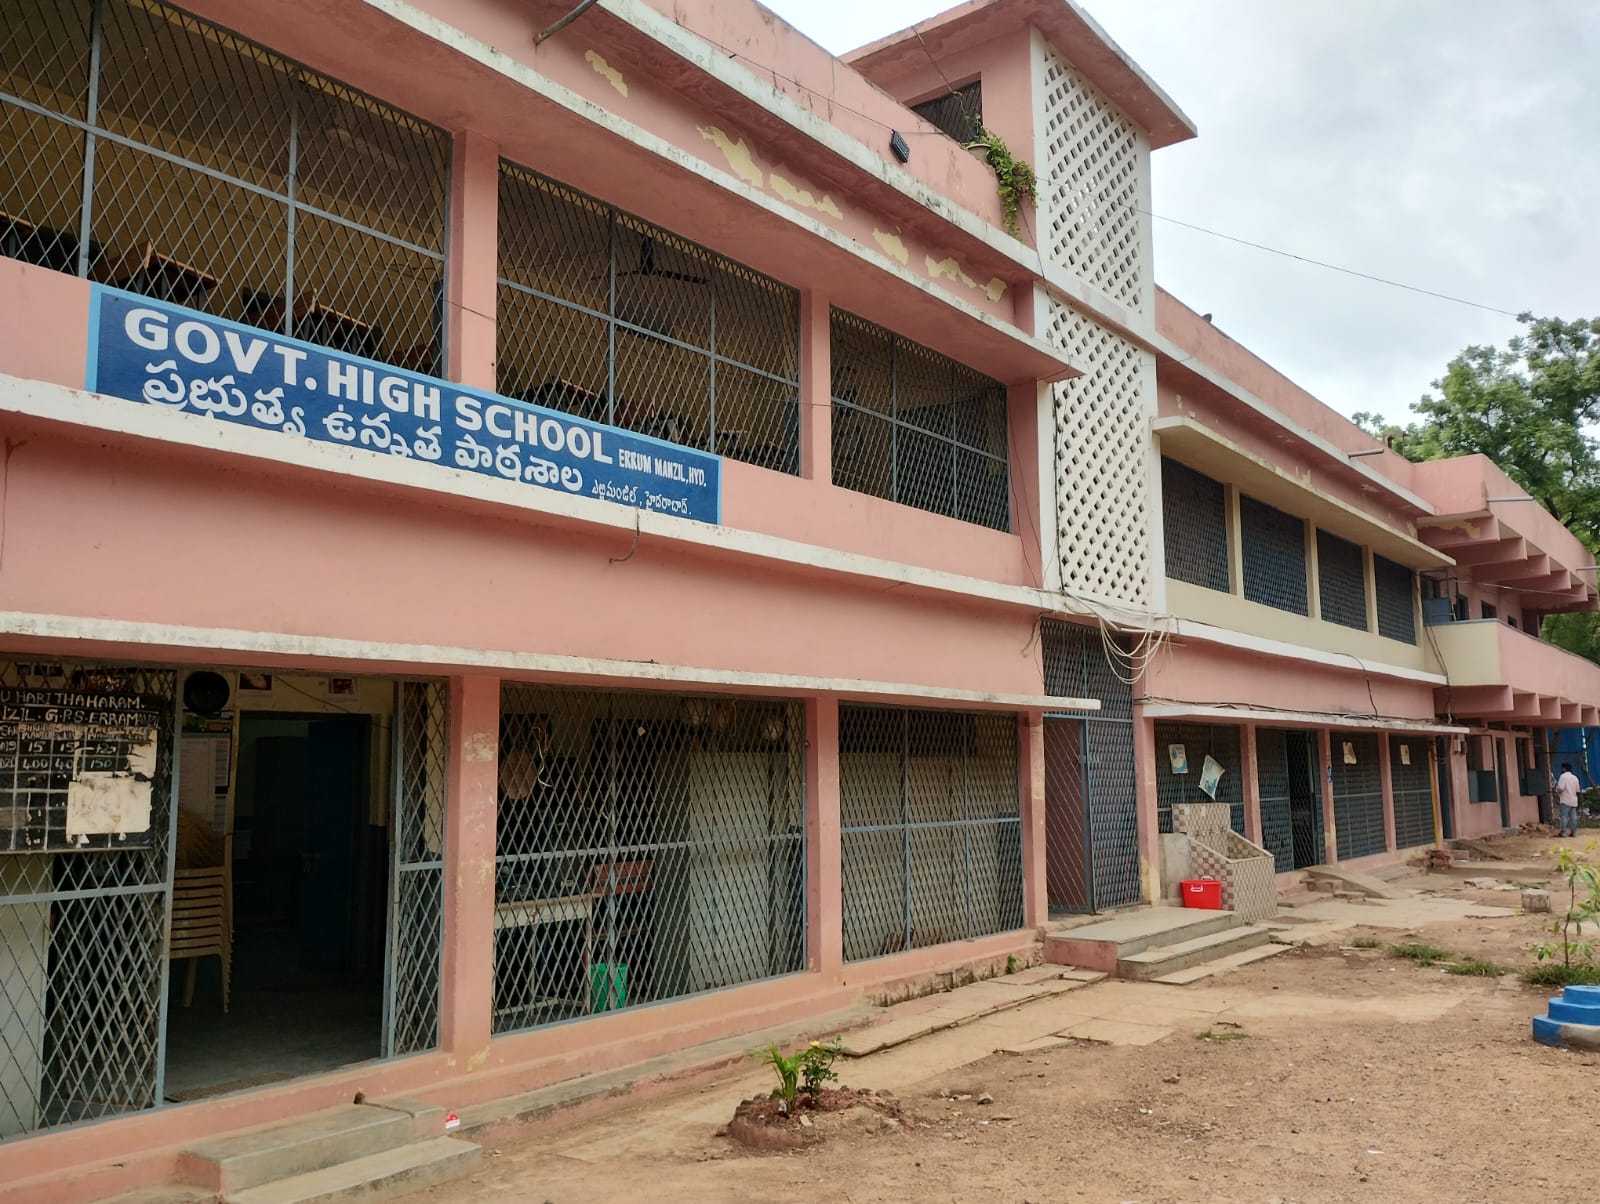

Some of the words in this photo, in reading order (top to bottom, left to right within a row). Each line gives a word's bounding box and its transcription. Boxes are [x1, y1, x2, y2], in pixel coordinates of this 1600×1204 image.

[124, 308, 317, 390] GOVT.
[328, 360, 440, 421] HIGH
[455, 396, 613, 464] SCHOOL
[618, 448, 652, 474] ERRUM
[322, 404, 442, 460] ఉన్నత
[23, 759, 48, 769] 400
[28, 741, 46, 753] 15
